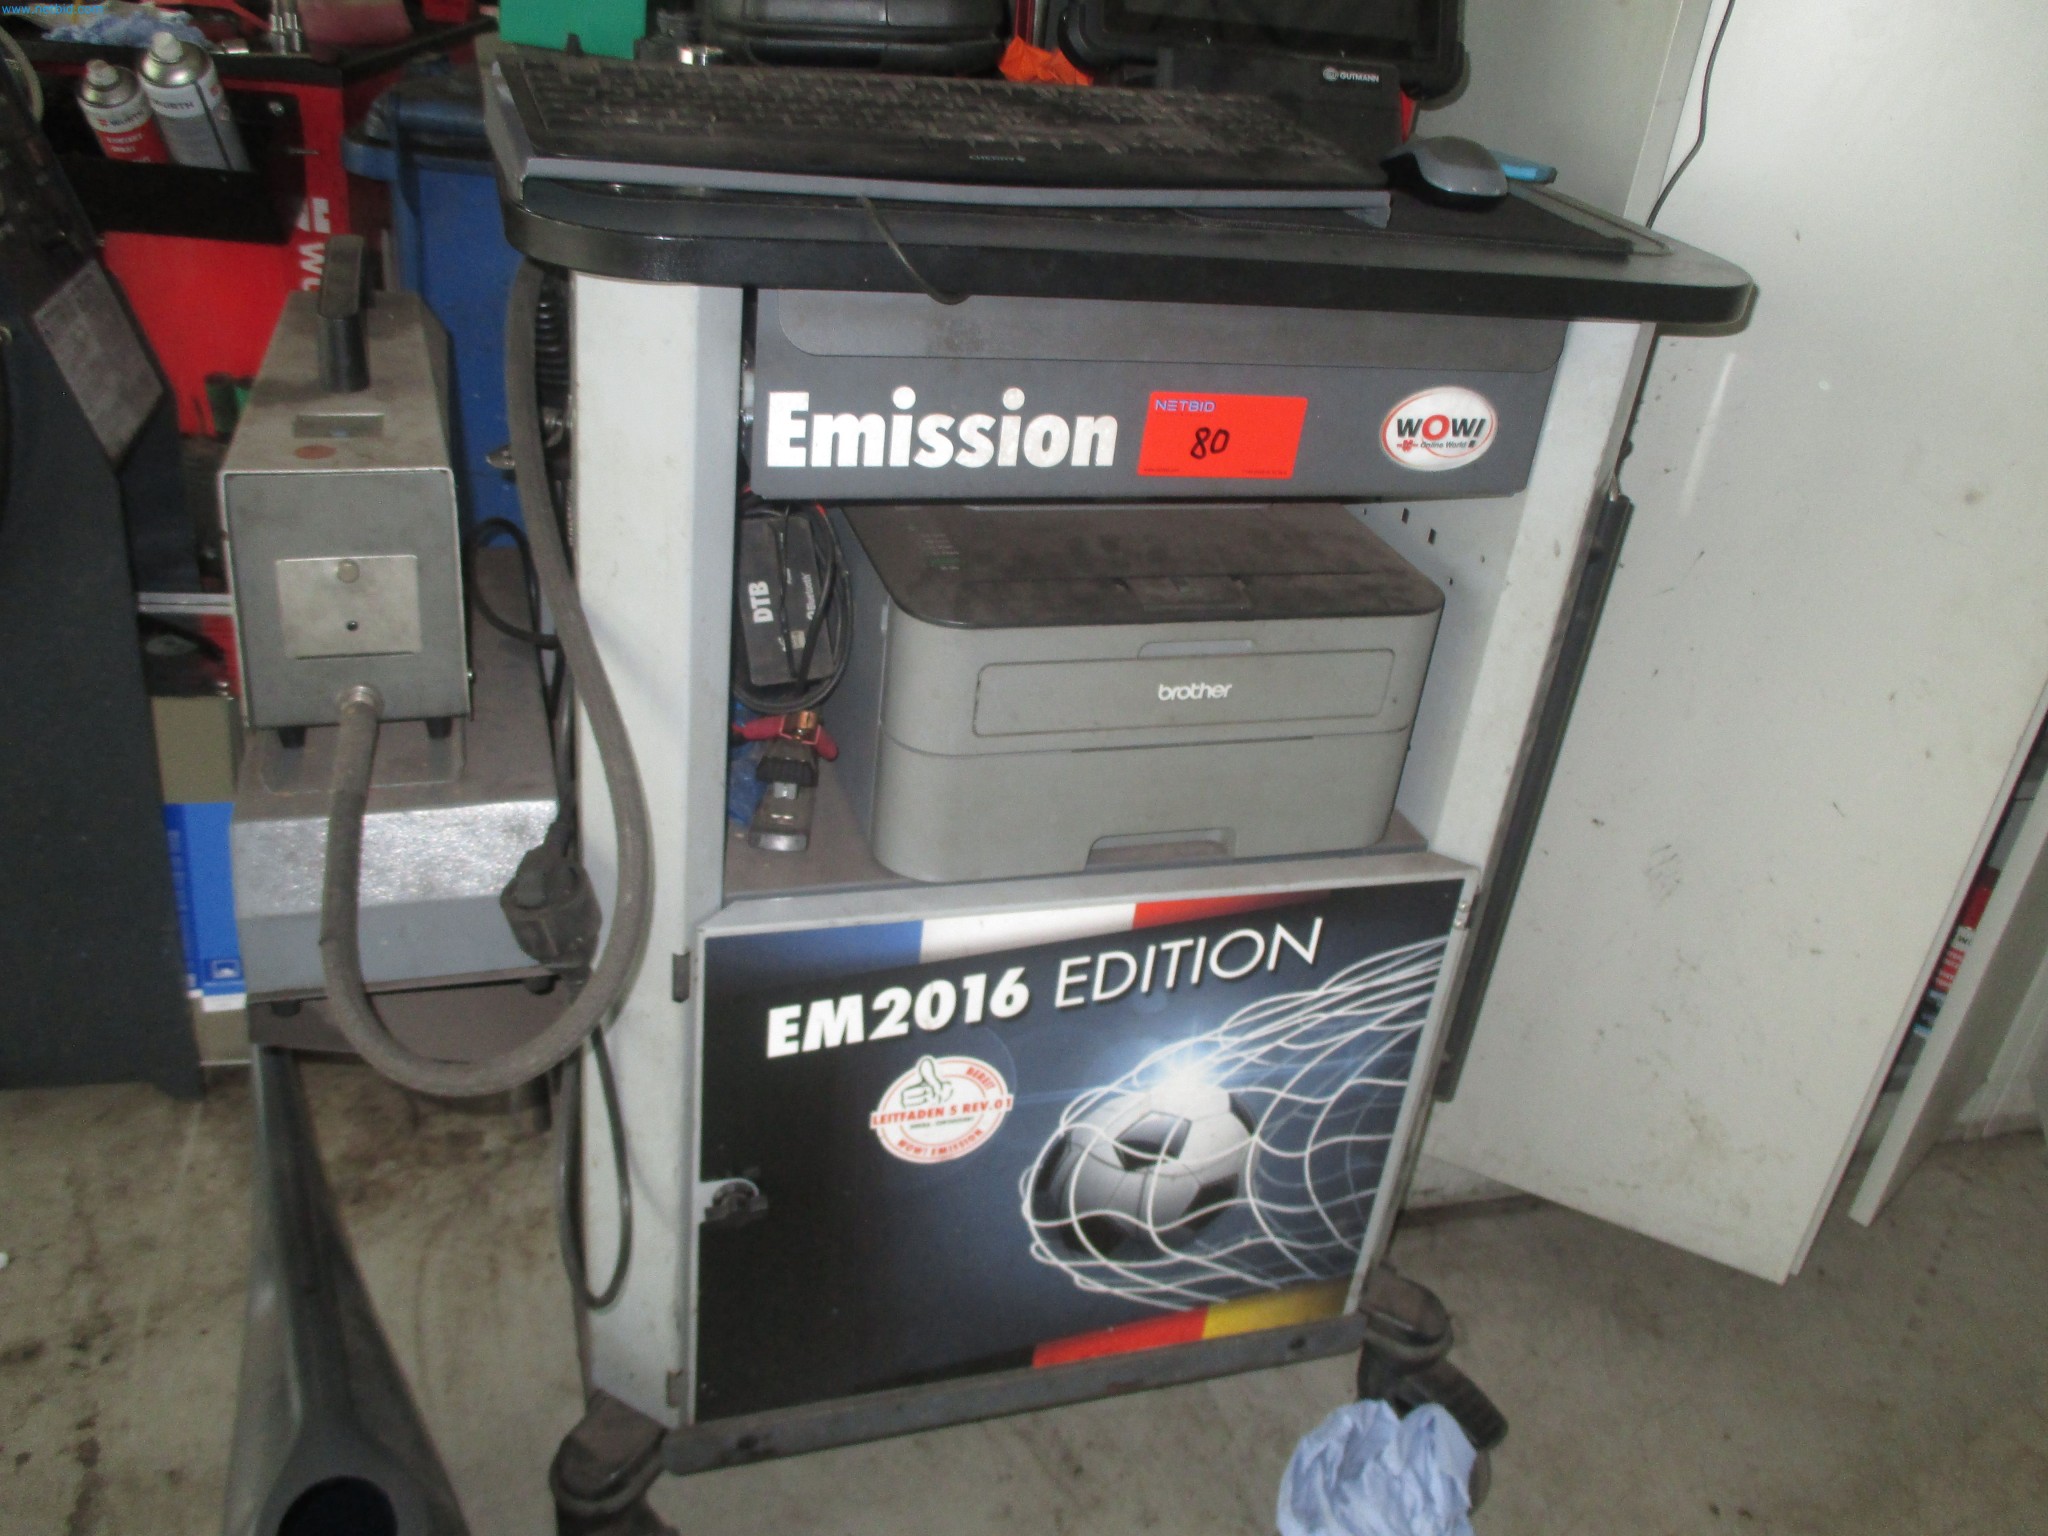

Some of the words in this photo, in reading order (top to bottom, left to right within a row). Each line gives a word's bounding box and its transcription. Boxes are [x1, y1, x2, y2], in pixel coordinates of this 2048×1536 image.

[1340, 70, 1380, 83] GUTMANN
[1155, 400, 1216, 413] NETBID
[766, 386, 1118, 468] Emission
[1396, 414, 1487, 448] WOW!
[1190, 427, 1230, 460] 80
[1420, 441, 1444, 450] Online
[1446, 441, 1468, 450] World
[748, 580, 774, 624] DTB
[1158, 682, 1233, 701] brother
[766, 967, 1029, 1059] EM2016
[1055, 917, 1324, 1009] EDITION
[872, 1106, 945, 1126] LEITFADEN
[950, 1103, 957, 1117] 5
[930, 1129, 983, 1157] EMISSION
